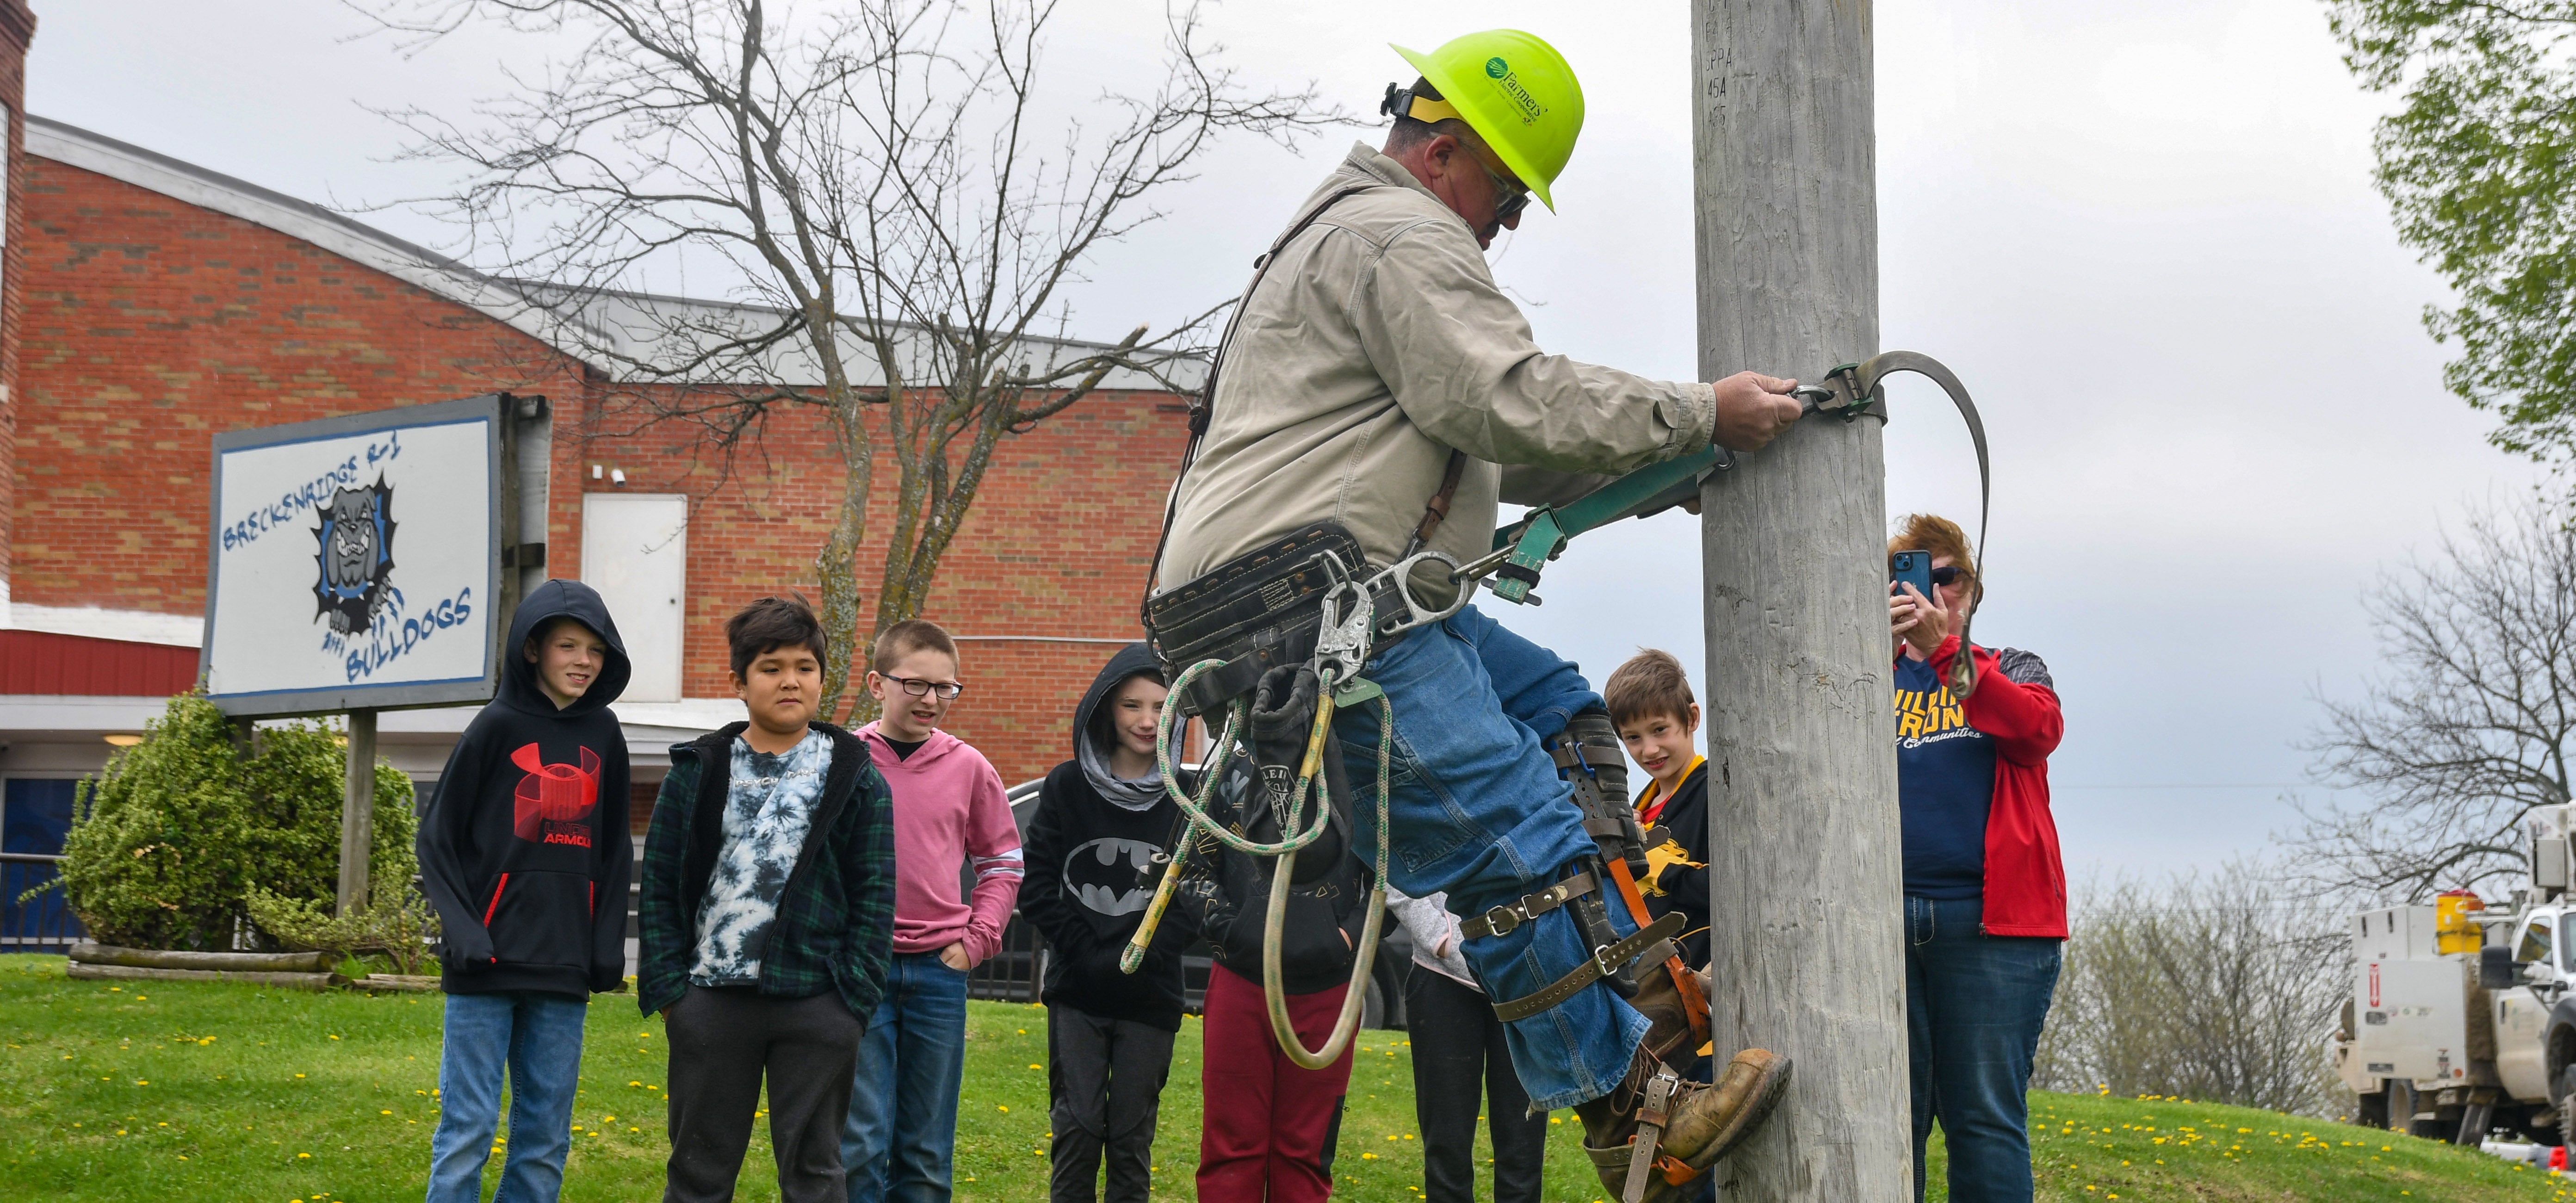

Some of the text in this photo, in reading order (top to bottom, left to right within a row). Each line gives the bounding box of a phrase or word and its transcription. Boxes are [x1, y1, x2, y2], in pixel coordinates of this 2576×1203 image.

[1499, 80, 1537, 123] Electric Cooperative
[224, 430, 402, 552] BRECKENRIDGE R-1
[347, 586, 471, 683] BULLDOGS
[735, 776, 780, 787] PSYCH
[544, 833, 591, 848] ARMOU
[545, 822, 591, 837] UNDE
